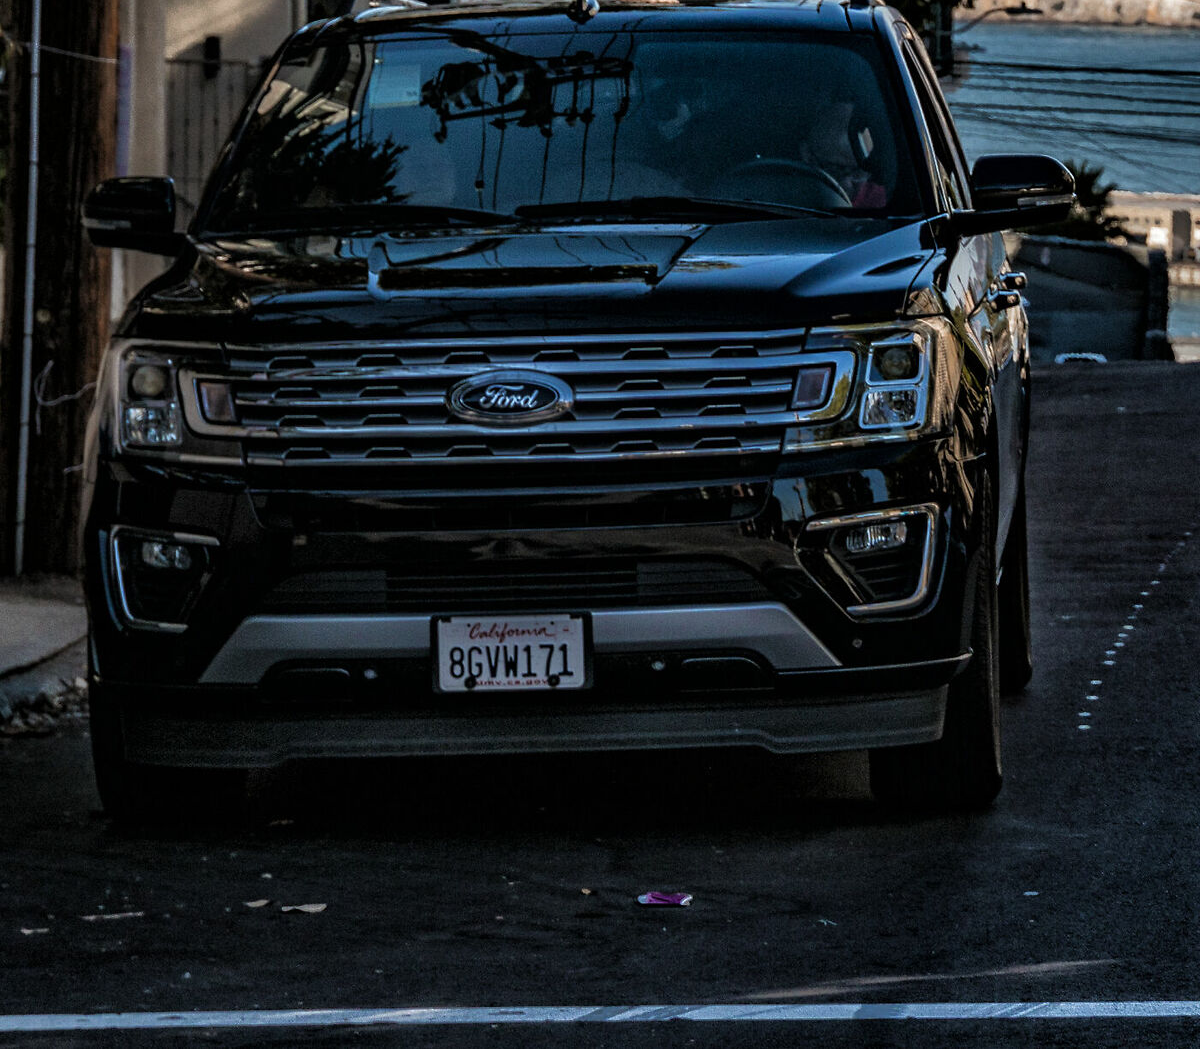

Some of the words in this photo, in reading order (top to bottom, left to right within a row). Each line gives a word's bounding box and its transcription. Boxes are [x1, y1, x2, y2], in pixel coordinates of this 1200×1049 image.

[480, 384, 539, 408] Ford
[468, 623, 556, 643] California
[450, 644, 574, 679] 8GVW171
